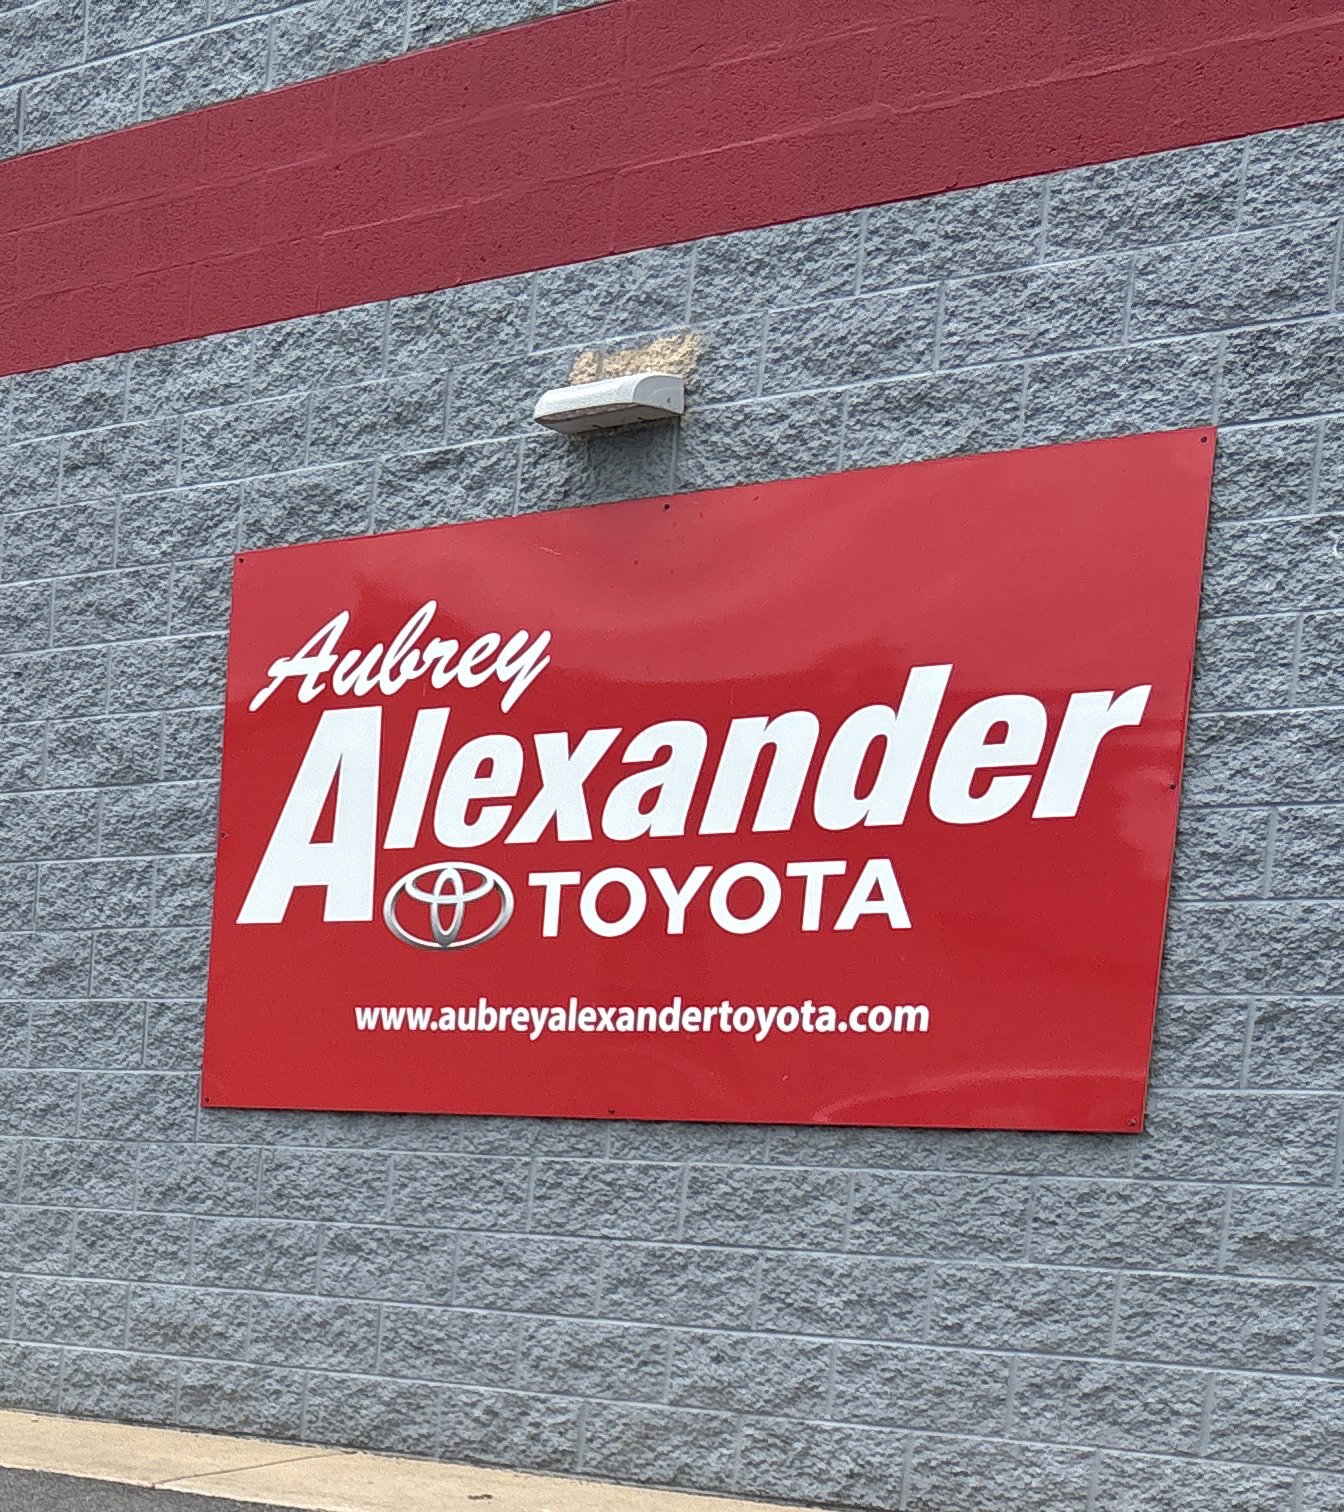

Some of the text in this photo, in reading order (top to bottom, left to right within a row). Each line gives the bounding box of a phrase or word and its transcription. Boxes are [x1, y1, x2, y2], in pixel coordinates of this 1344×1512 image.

[248, 599, 552, 714] Aubrey
[235, 663, 1153, 925] Alexander
[527, 858, 912, 938] TOYOTA
[354, 996, 930, 1043] www.aubreyalexandertoyota.com
